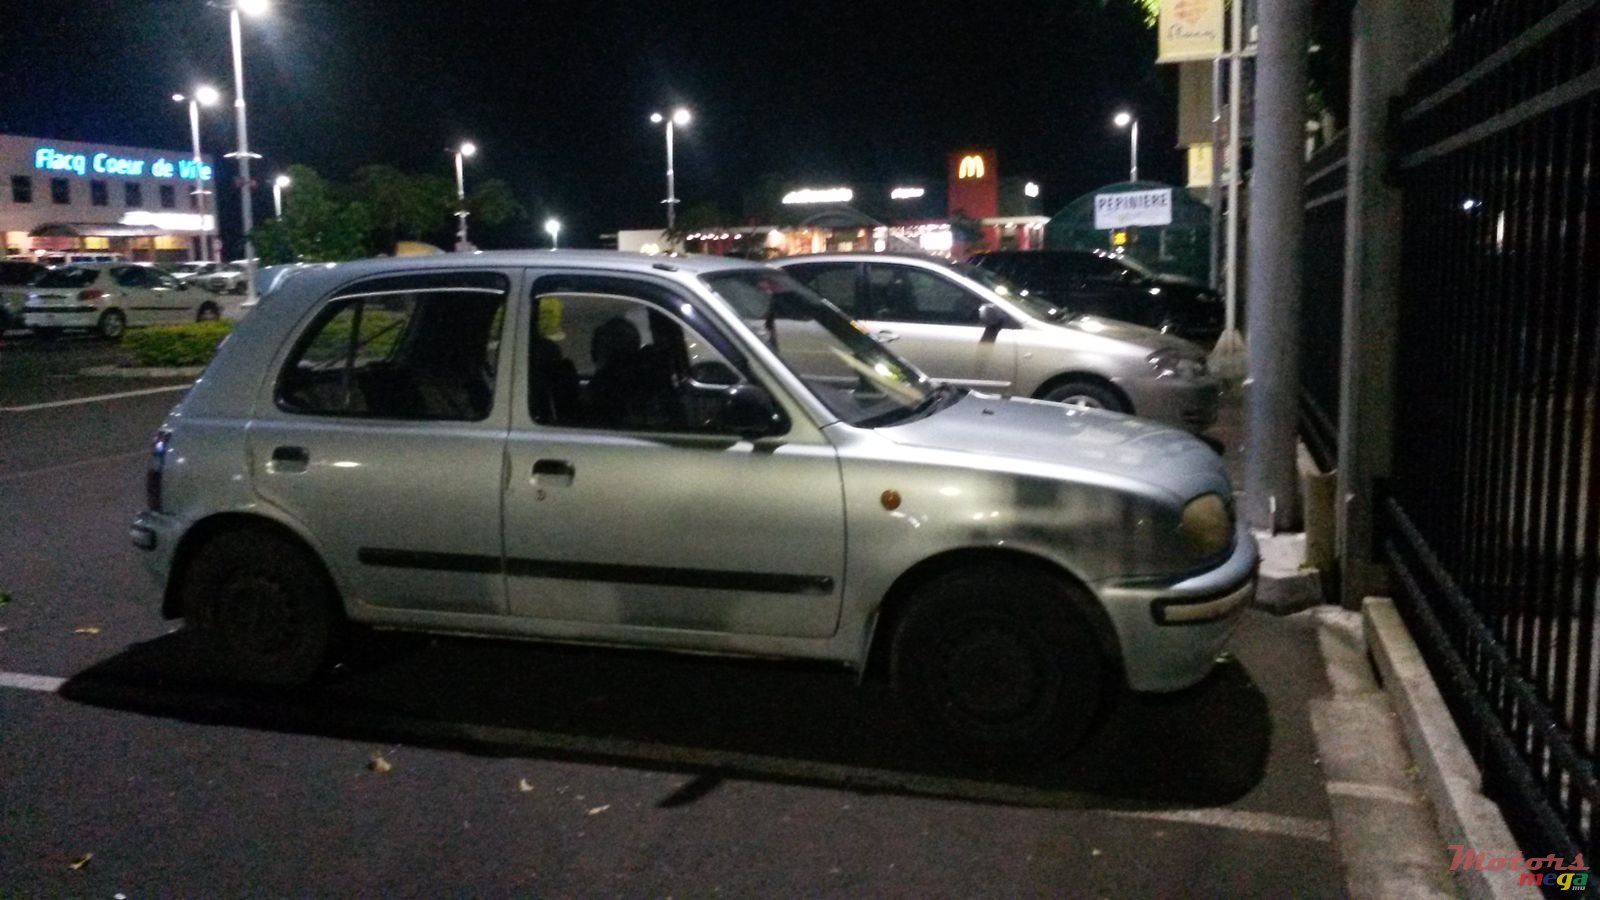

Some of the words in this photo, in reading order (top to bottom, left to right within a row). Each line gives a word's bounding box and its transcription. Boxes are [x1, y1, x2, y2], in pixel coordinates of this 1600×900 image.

[35, 148, 85, 175] Flacq
[93, 153, 145, 175] Coeur
[151, 158, 174, 177] de
[178, 159, 212, 180] Vie
